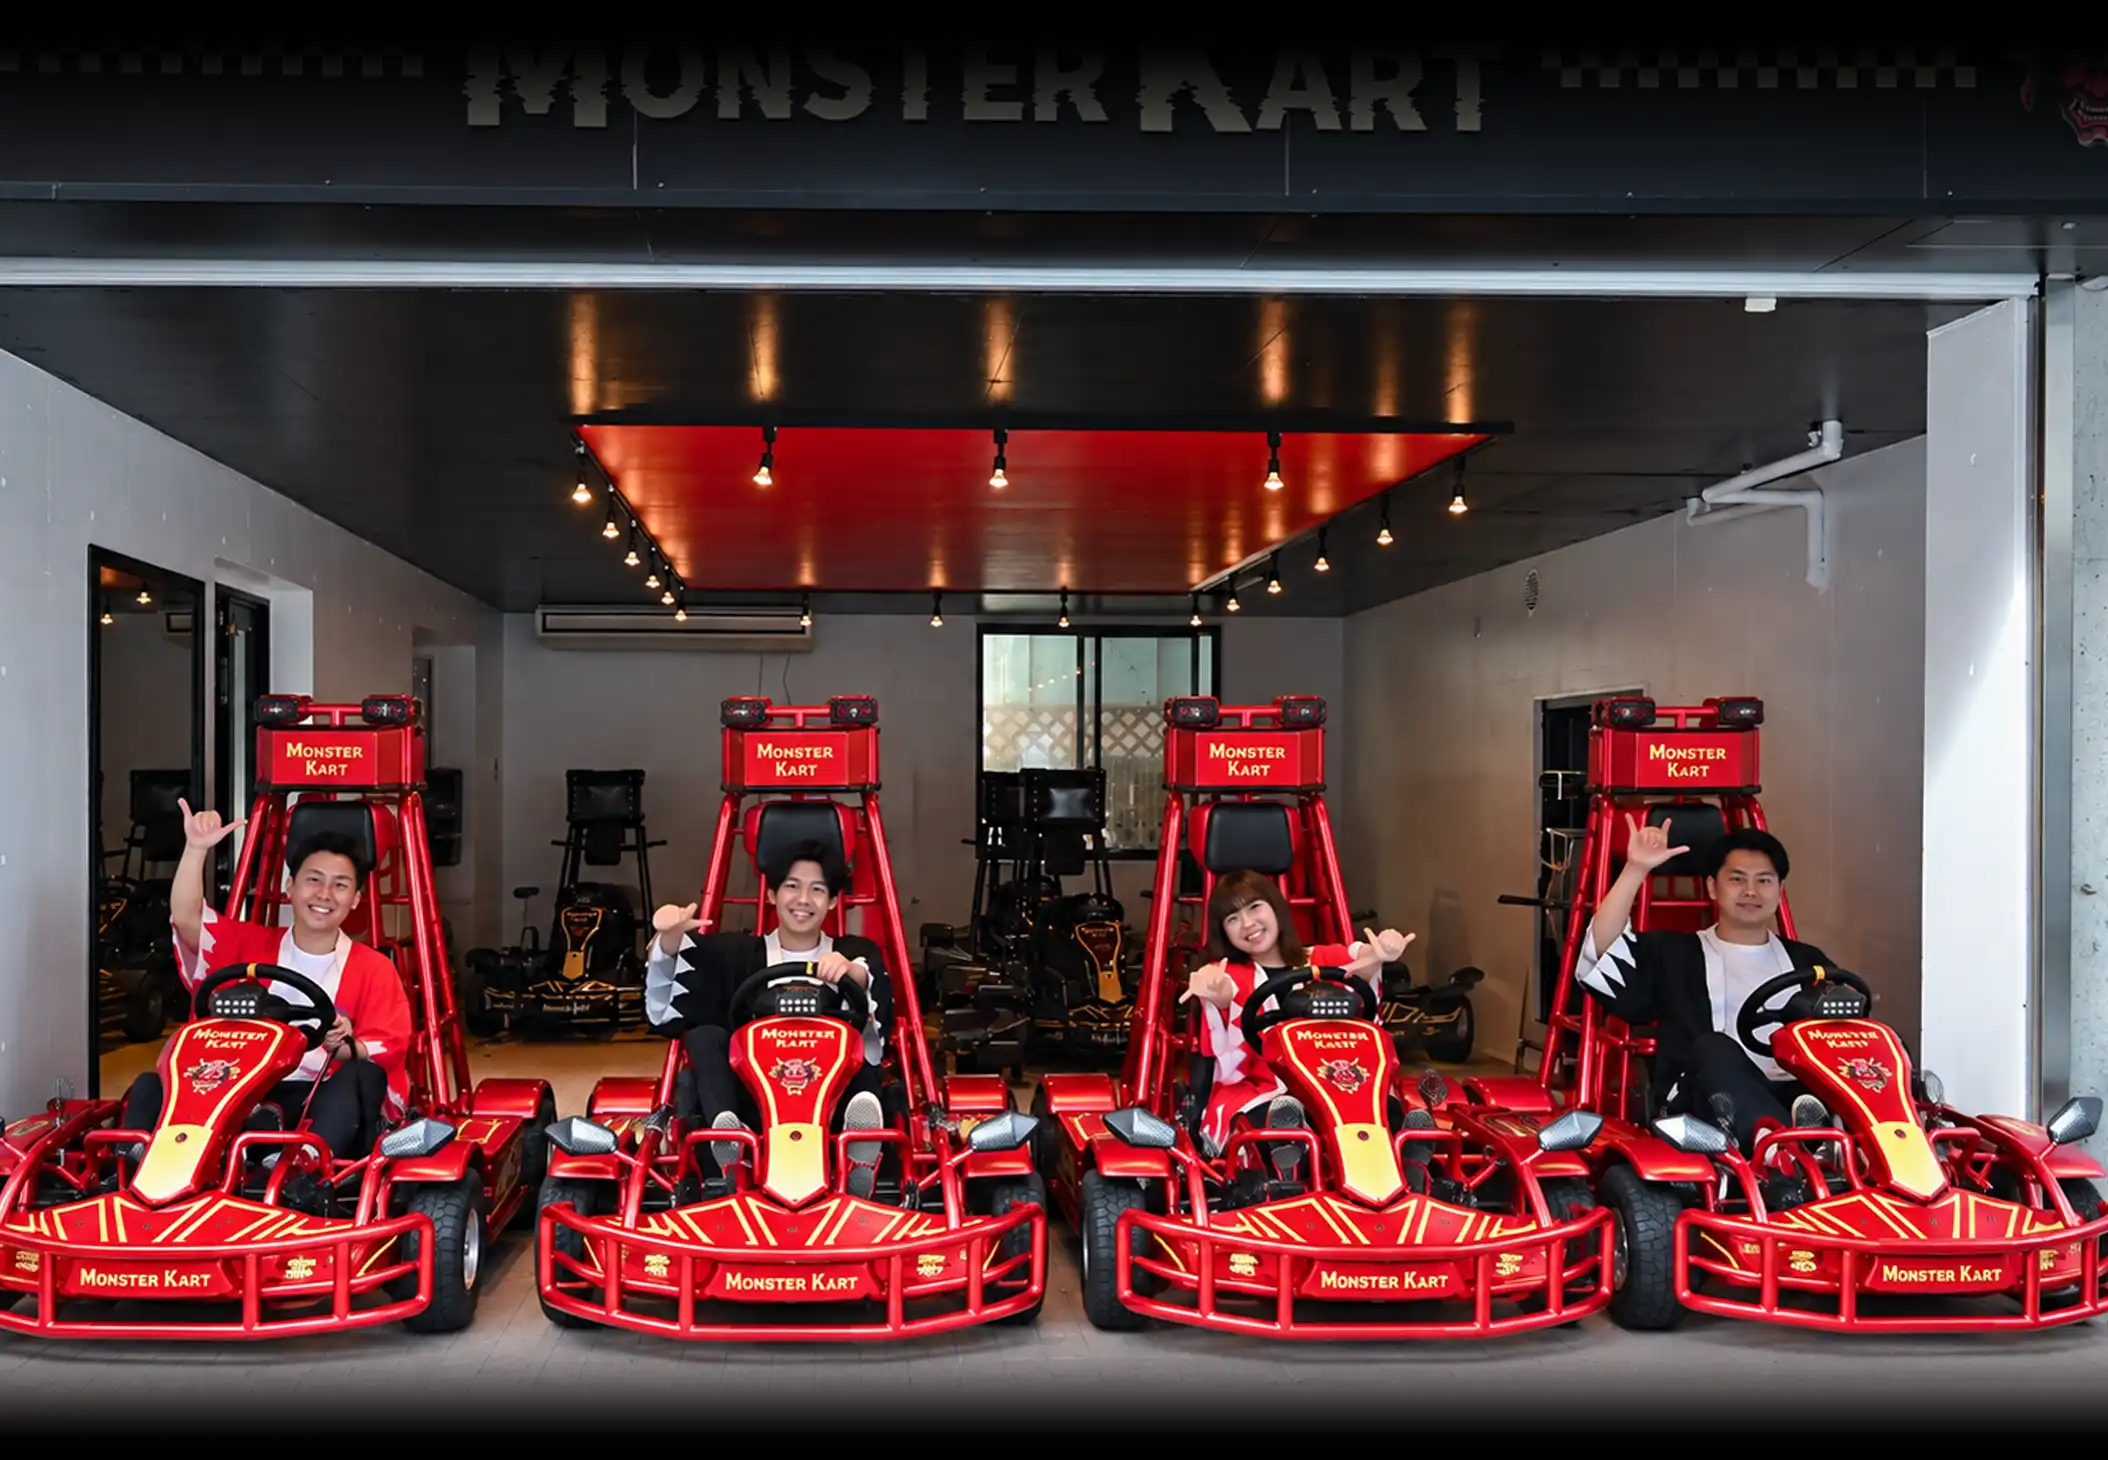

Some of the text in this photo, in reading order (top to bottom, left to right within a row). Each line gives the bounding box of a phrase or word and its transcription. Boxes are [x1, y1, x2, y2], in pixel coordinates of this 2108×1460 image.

[461, 34, 1504, 134] MONSTER KART
[286, 742, 363, 759] MONSTER
[757, 743, 833, 759] MONSTER
[1209, 742, 1286, 759] MONSTER
[1649, 743, 1727, 761] MONSTER
[305, 759, 348, 776] KART
[775, 760, 818, 777] KART
[1227, 760, 1271, 777] KART
[1667, 761, 1710, 778] KART
[80, 1267, 211, 1288] MONSTER KART
[725, 1272, 859, 1291] MONSTER KART
[1320, 1270, 1449, 1289] MONSTER KART
[1882, 1264, 2003, 1282] MONSTER KART
